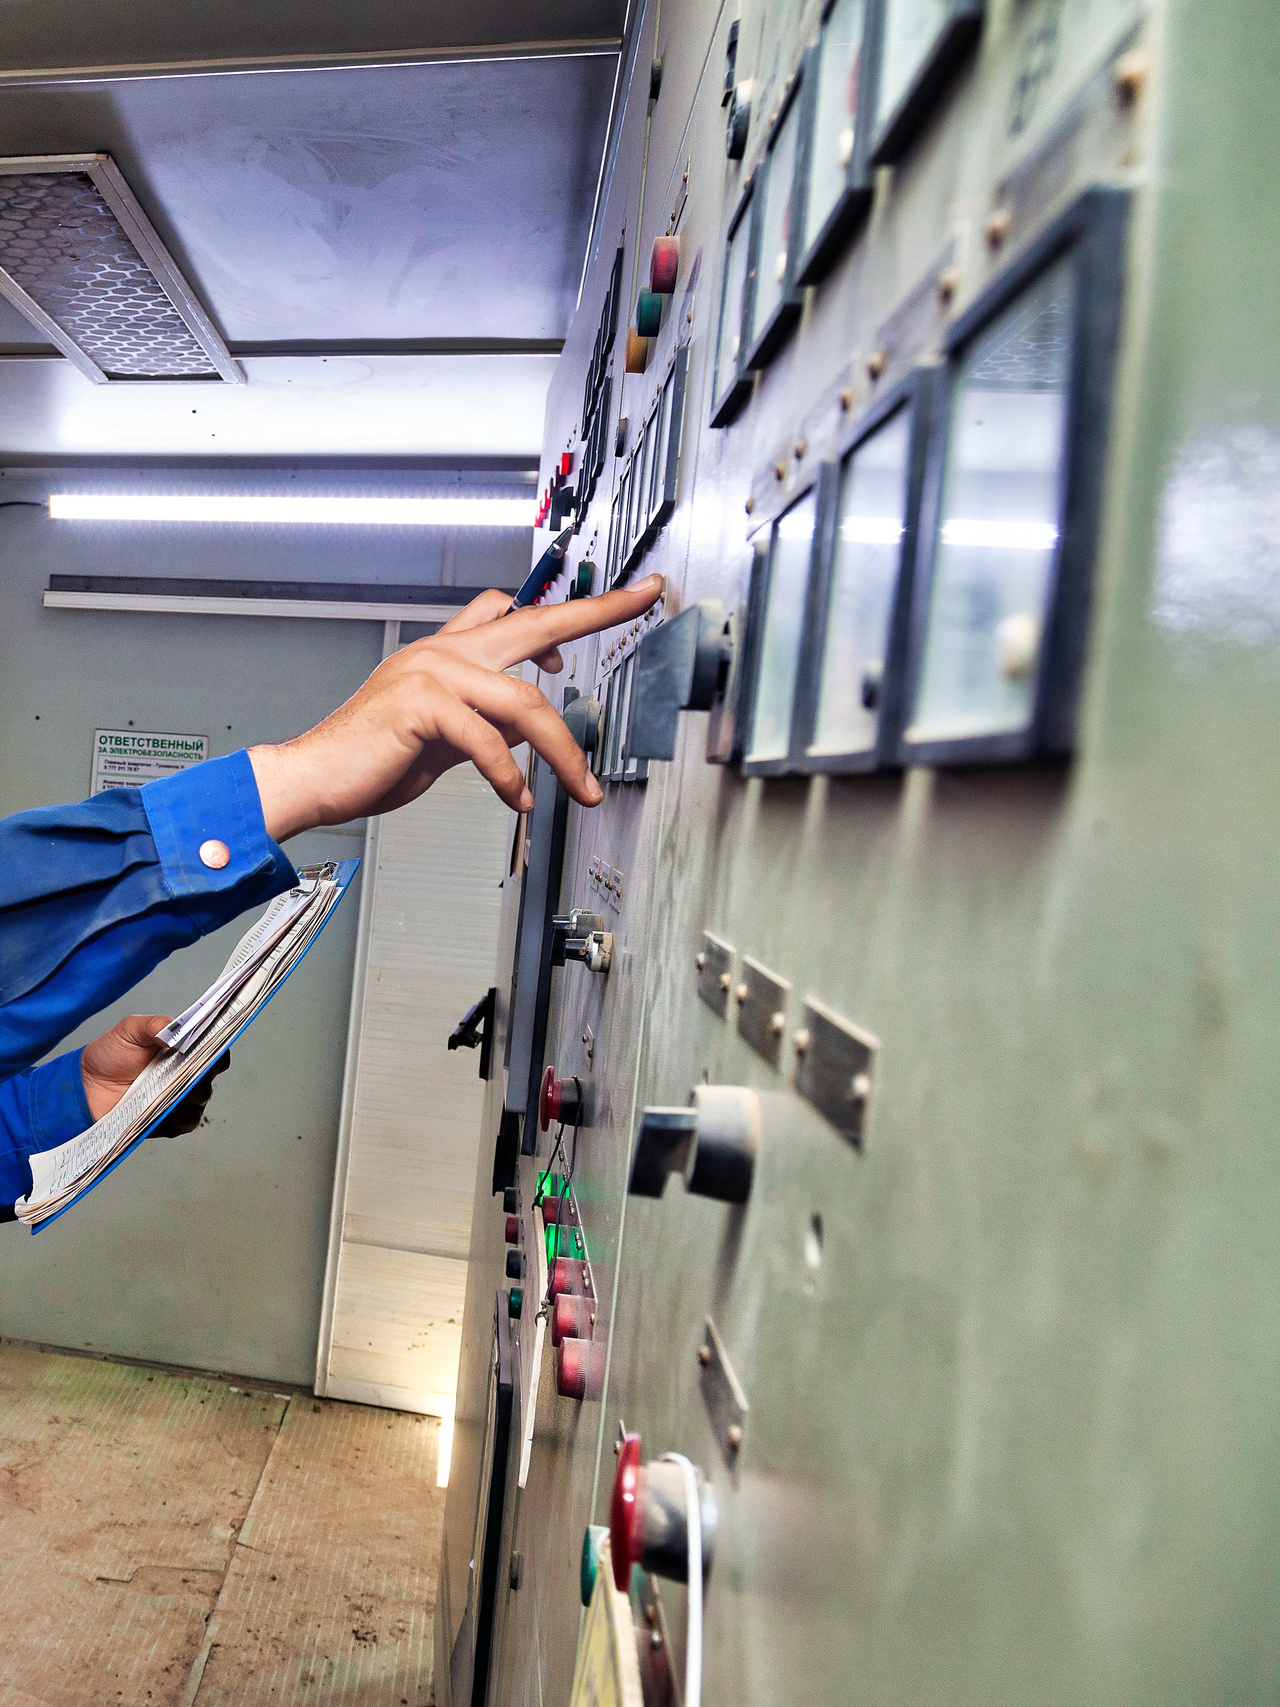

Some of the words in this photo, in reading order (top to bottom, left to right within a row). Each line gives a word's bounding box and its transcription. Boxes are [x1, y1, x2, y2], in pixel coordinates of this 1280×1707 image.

[98, 735, 204, 752] ОТВЕТСТВЕННЫЙ
[97, 746, 107, 754] ЗА
[109, 747, 204, 760] ЭЛЕКТРОБЕЗОПАСНОСТЬ
